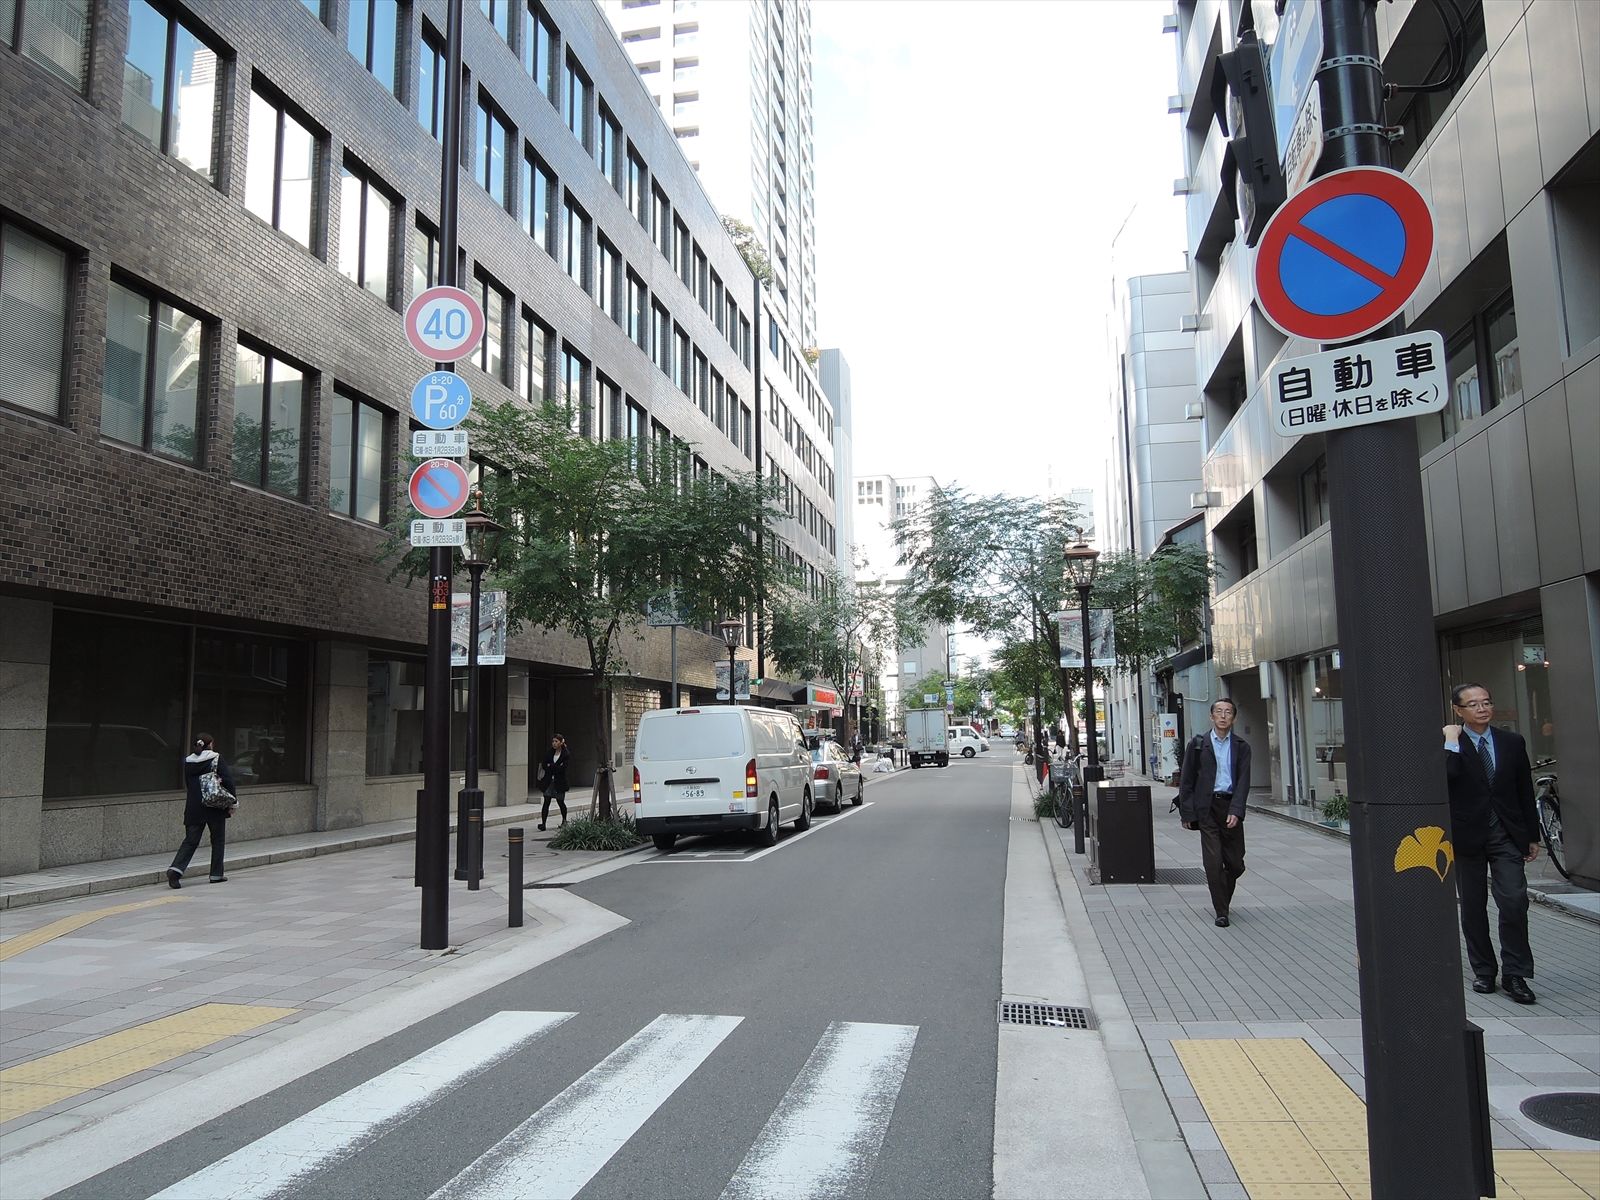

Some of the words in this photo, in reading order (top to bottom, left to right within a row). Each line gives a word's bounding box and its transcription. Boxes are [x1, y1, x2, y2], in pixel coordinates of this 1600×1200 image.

[423, 308, 466, 340] 40
[1278, 342, 1436, 403] 自動車
[431, 376, 452, 384] 8-20
[424, 385, 448, 420] P
[416, 433, 465, 444] 自動車
[430, 461, 449, 469] 20-8
[414, 522, 463, 533] 自動車
